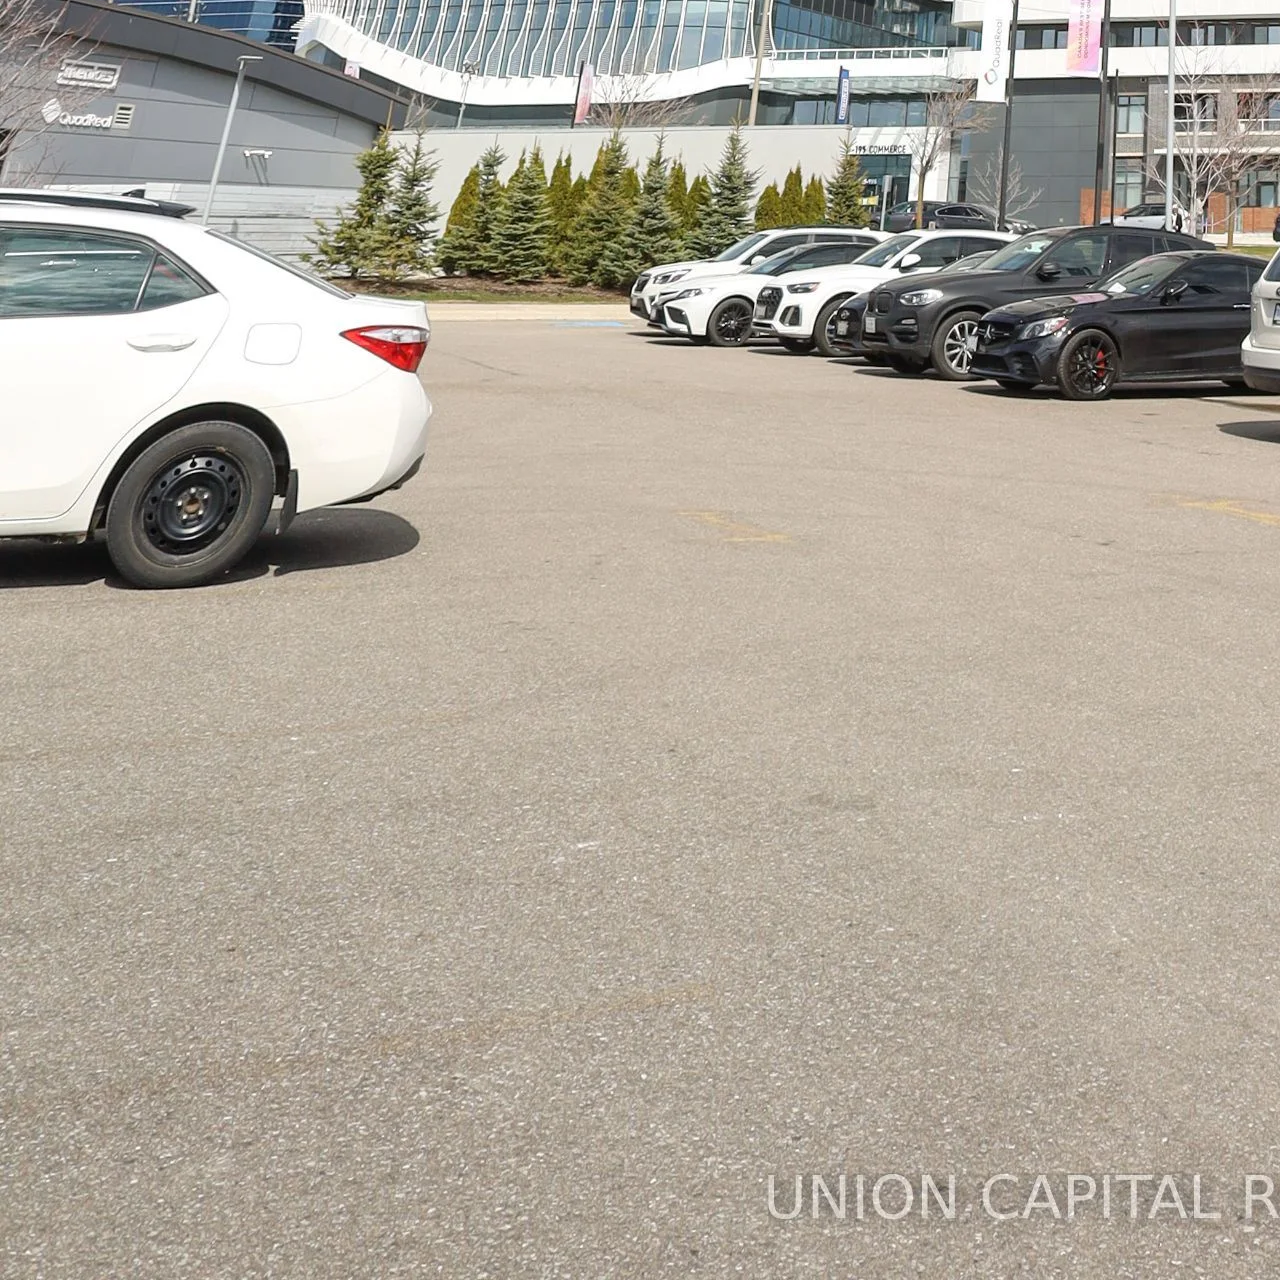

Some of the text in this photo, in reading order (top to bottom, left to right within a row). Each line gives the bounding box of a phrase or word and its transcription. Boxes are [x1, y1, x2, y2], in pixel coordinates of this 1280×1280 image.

[993, 18, 1003, 68] QuadReal
[59, 111, 113, 128] QuadReal
[868, 145, 906, 154] COMMERCE
